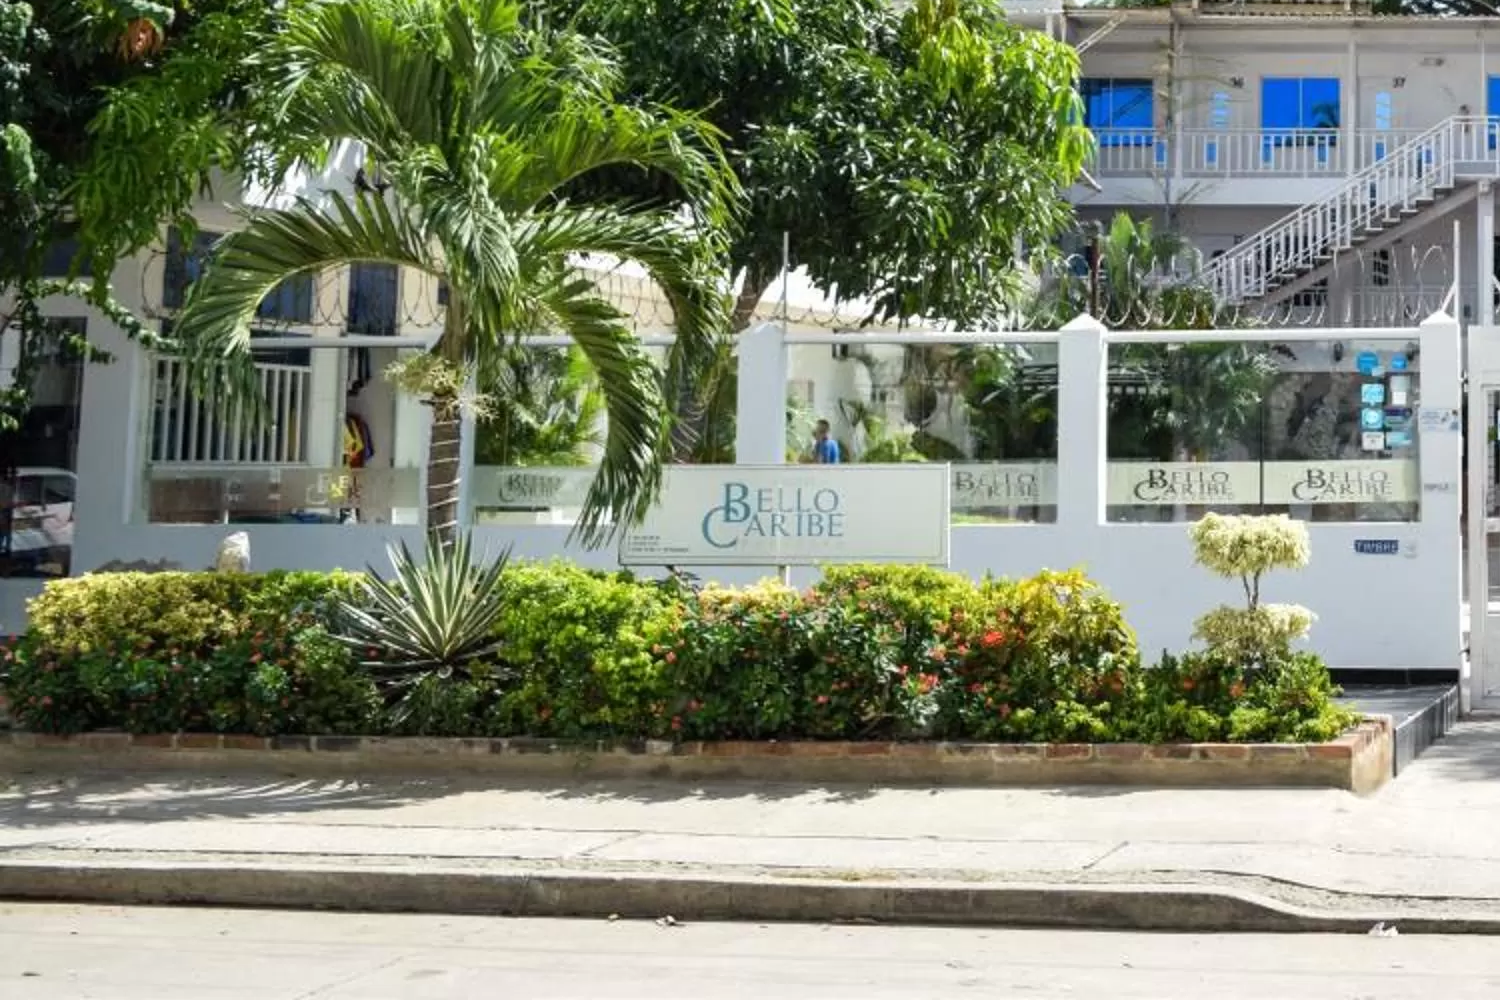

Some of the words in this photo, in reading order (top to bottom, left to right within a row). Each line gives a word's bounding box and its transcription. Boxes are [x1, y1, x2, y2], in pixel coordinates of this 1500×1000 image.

[1148, 469, 1229, 489] BELLO
[1306, 469, 1388, 489] BELLO
[1133, 479, 1233, 501] CARIBE
[1291, 480, 1393, 501] CARIBE
[723, 483, 839, 523] BELLO
[702, 504, 845, 549] CARIBE
